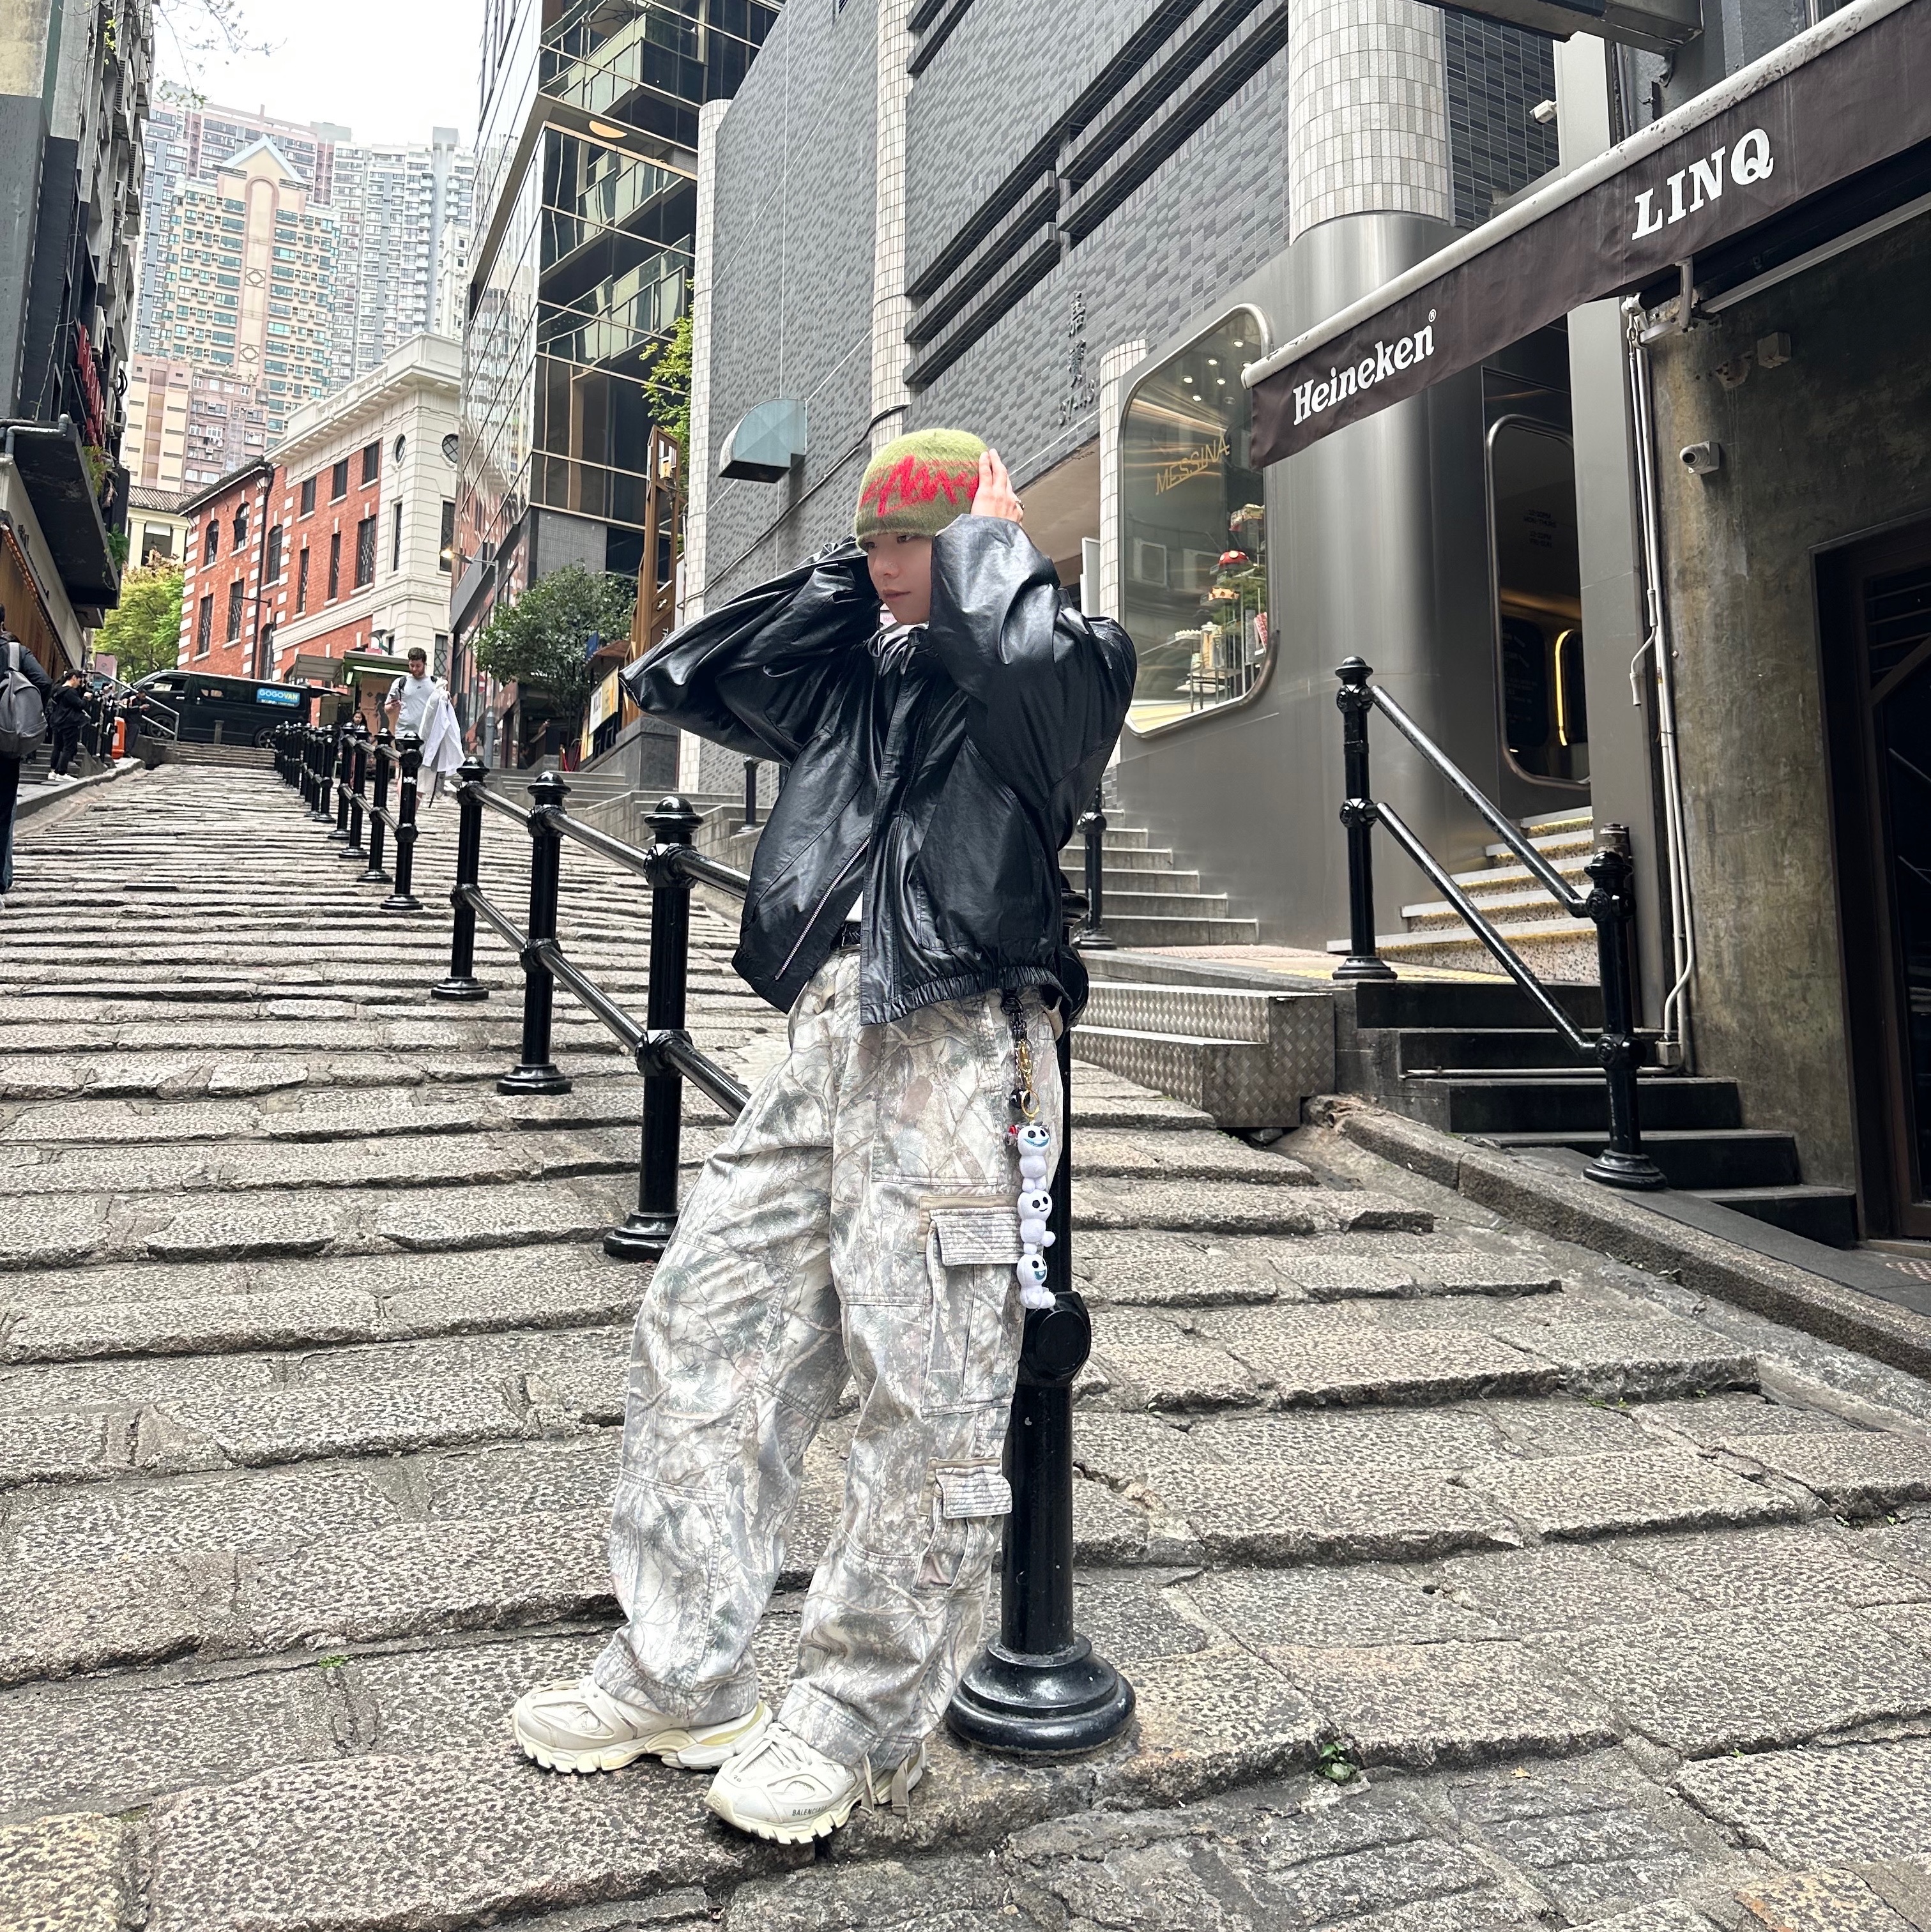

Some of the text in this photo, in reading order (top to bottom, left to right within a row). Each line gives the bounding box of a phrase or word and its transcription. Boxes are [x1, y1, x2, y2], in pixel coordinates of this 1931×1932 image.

[1631, 128, 1774, 241] LINQ
[1155, 433, 1230, 496] MESSINA
[259, 689, 298, 701] GOGOVAN
